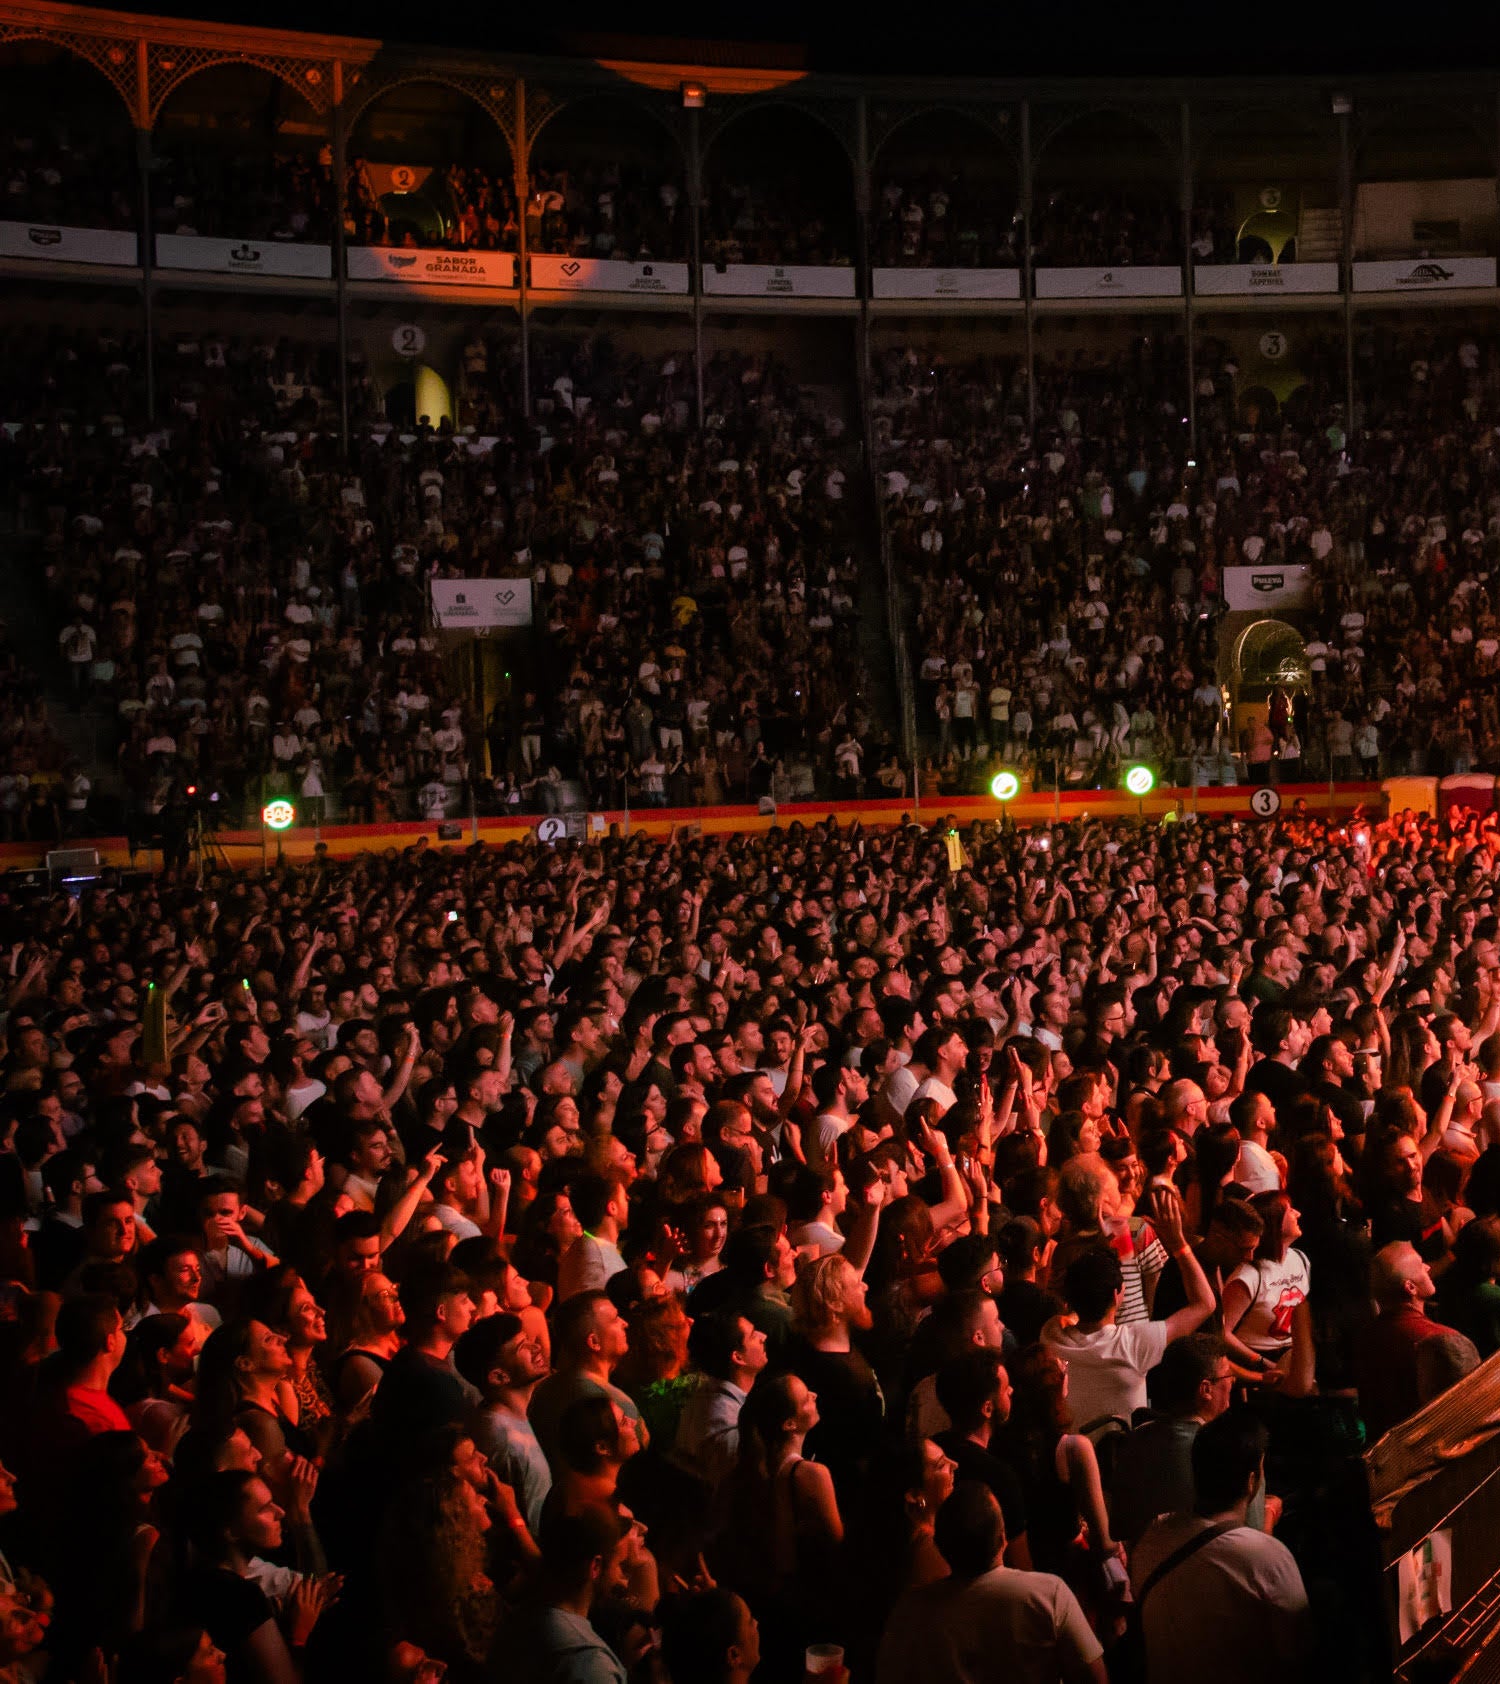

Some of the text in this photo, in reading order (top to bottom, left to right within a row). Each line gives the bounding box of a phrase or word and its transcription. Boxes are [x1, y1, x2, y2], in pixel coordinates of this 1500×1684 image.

[398, 170, 409, 185] 2
[426, 264, 486, 274] GRANADA
[436, 256, 476, 265] SABOR
[402, 329, 417, 351] 2
[1268, 335, 1280, 355] 3
[1260, 792, 1271, 812] 3
[263, 807, 294, 822] BAR
[546, 820, 559, 840] 2
